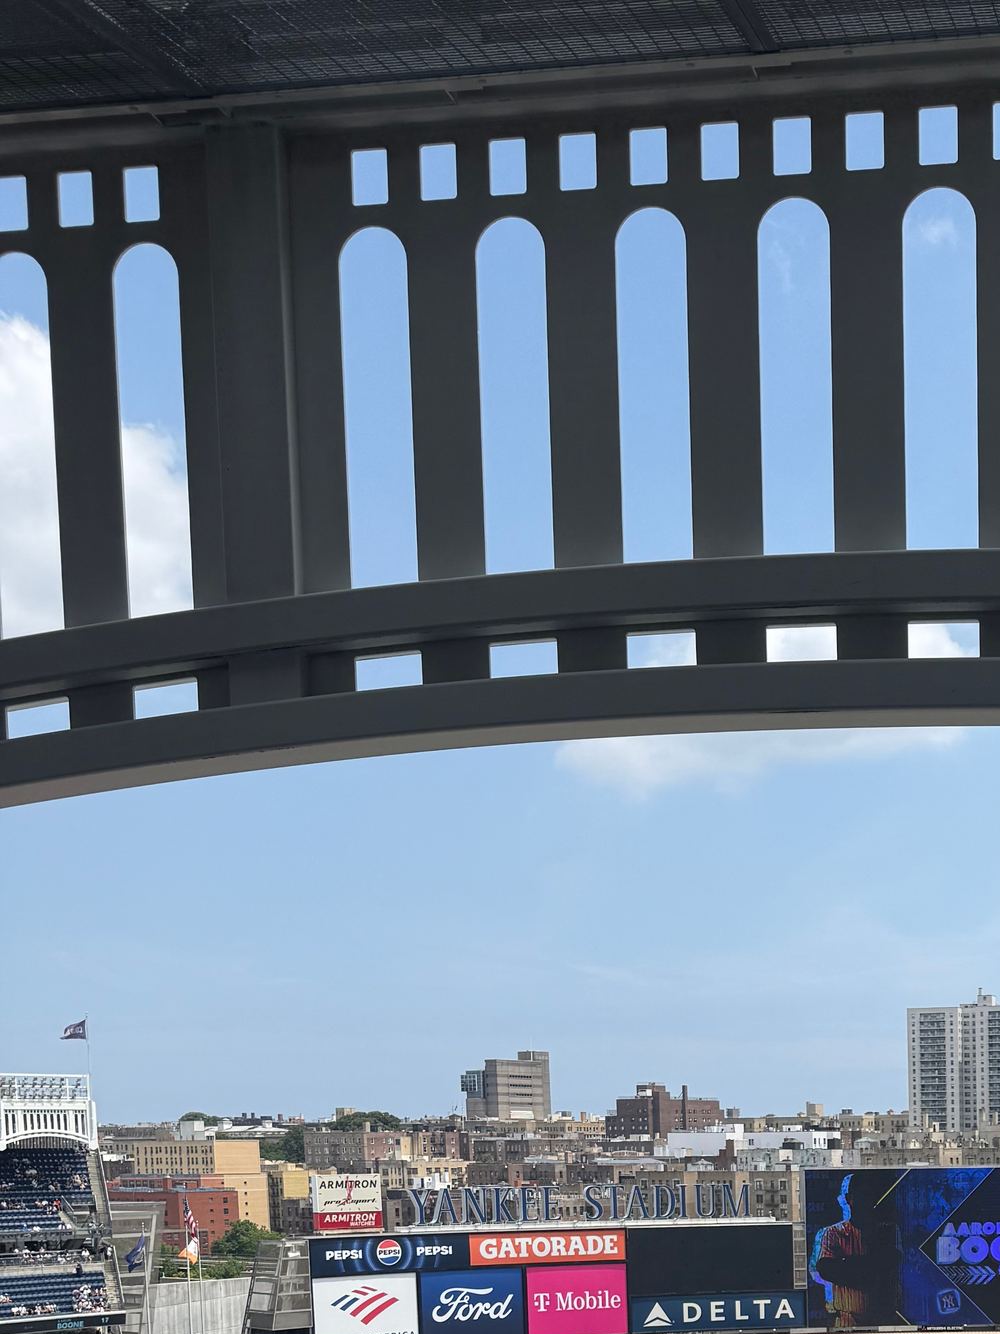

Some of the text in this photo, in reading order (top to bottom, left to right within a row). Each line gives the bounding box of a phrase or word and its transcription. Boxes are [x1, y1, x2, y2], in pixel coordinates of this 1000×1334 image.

[319, 1180, 377, 1190] ARMITRON
[406, 1183, 753, 1226] YANKEE STADIUM
[324, 1213, 376, 1223] ARMITRON
[378, 1248, 400, 1257] PEPSI
[416, 1245, 452, 1256] PEPSI
[479, 1234, 618, 1260] GATORADE
[325, 1249, 362, 1261] PEPSI
[432, 1287, 513, 1323] Ford
[534, 1290, 621, 1312] T Mobile
[683, 1298, 796, 1324] DELTA
[57, 1320, 84, 1329] BOONE
